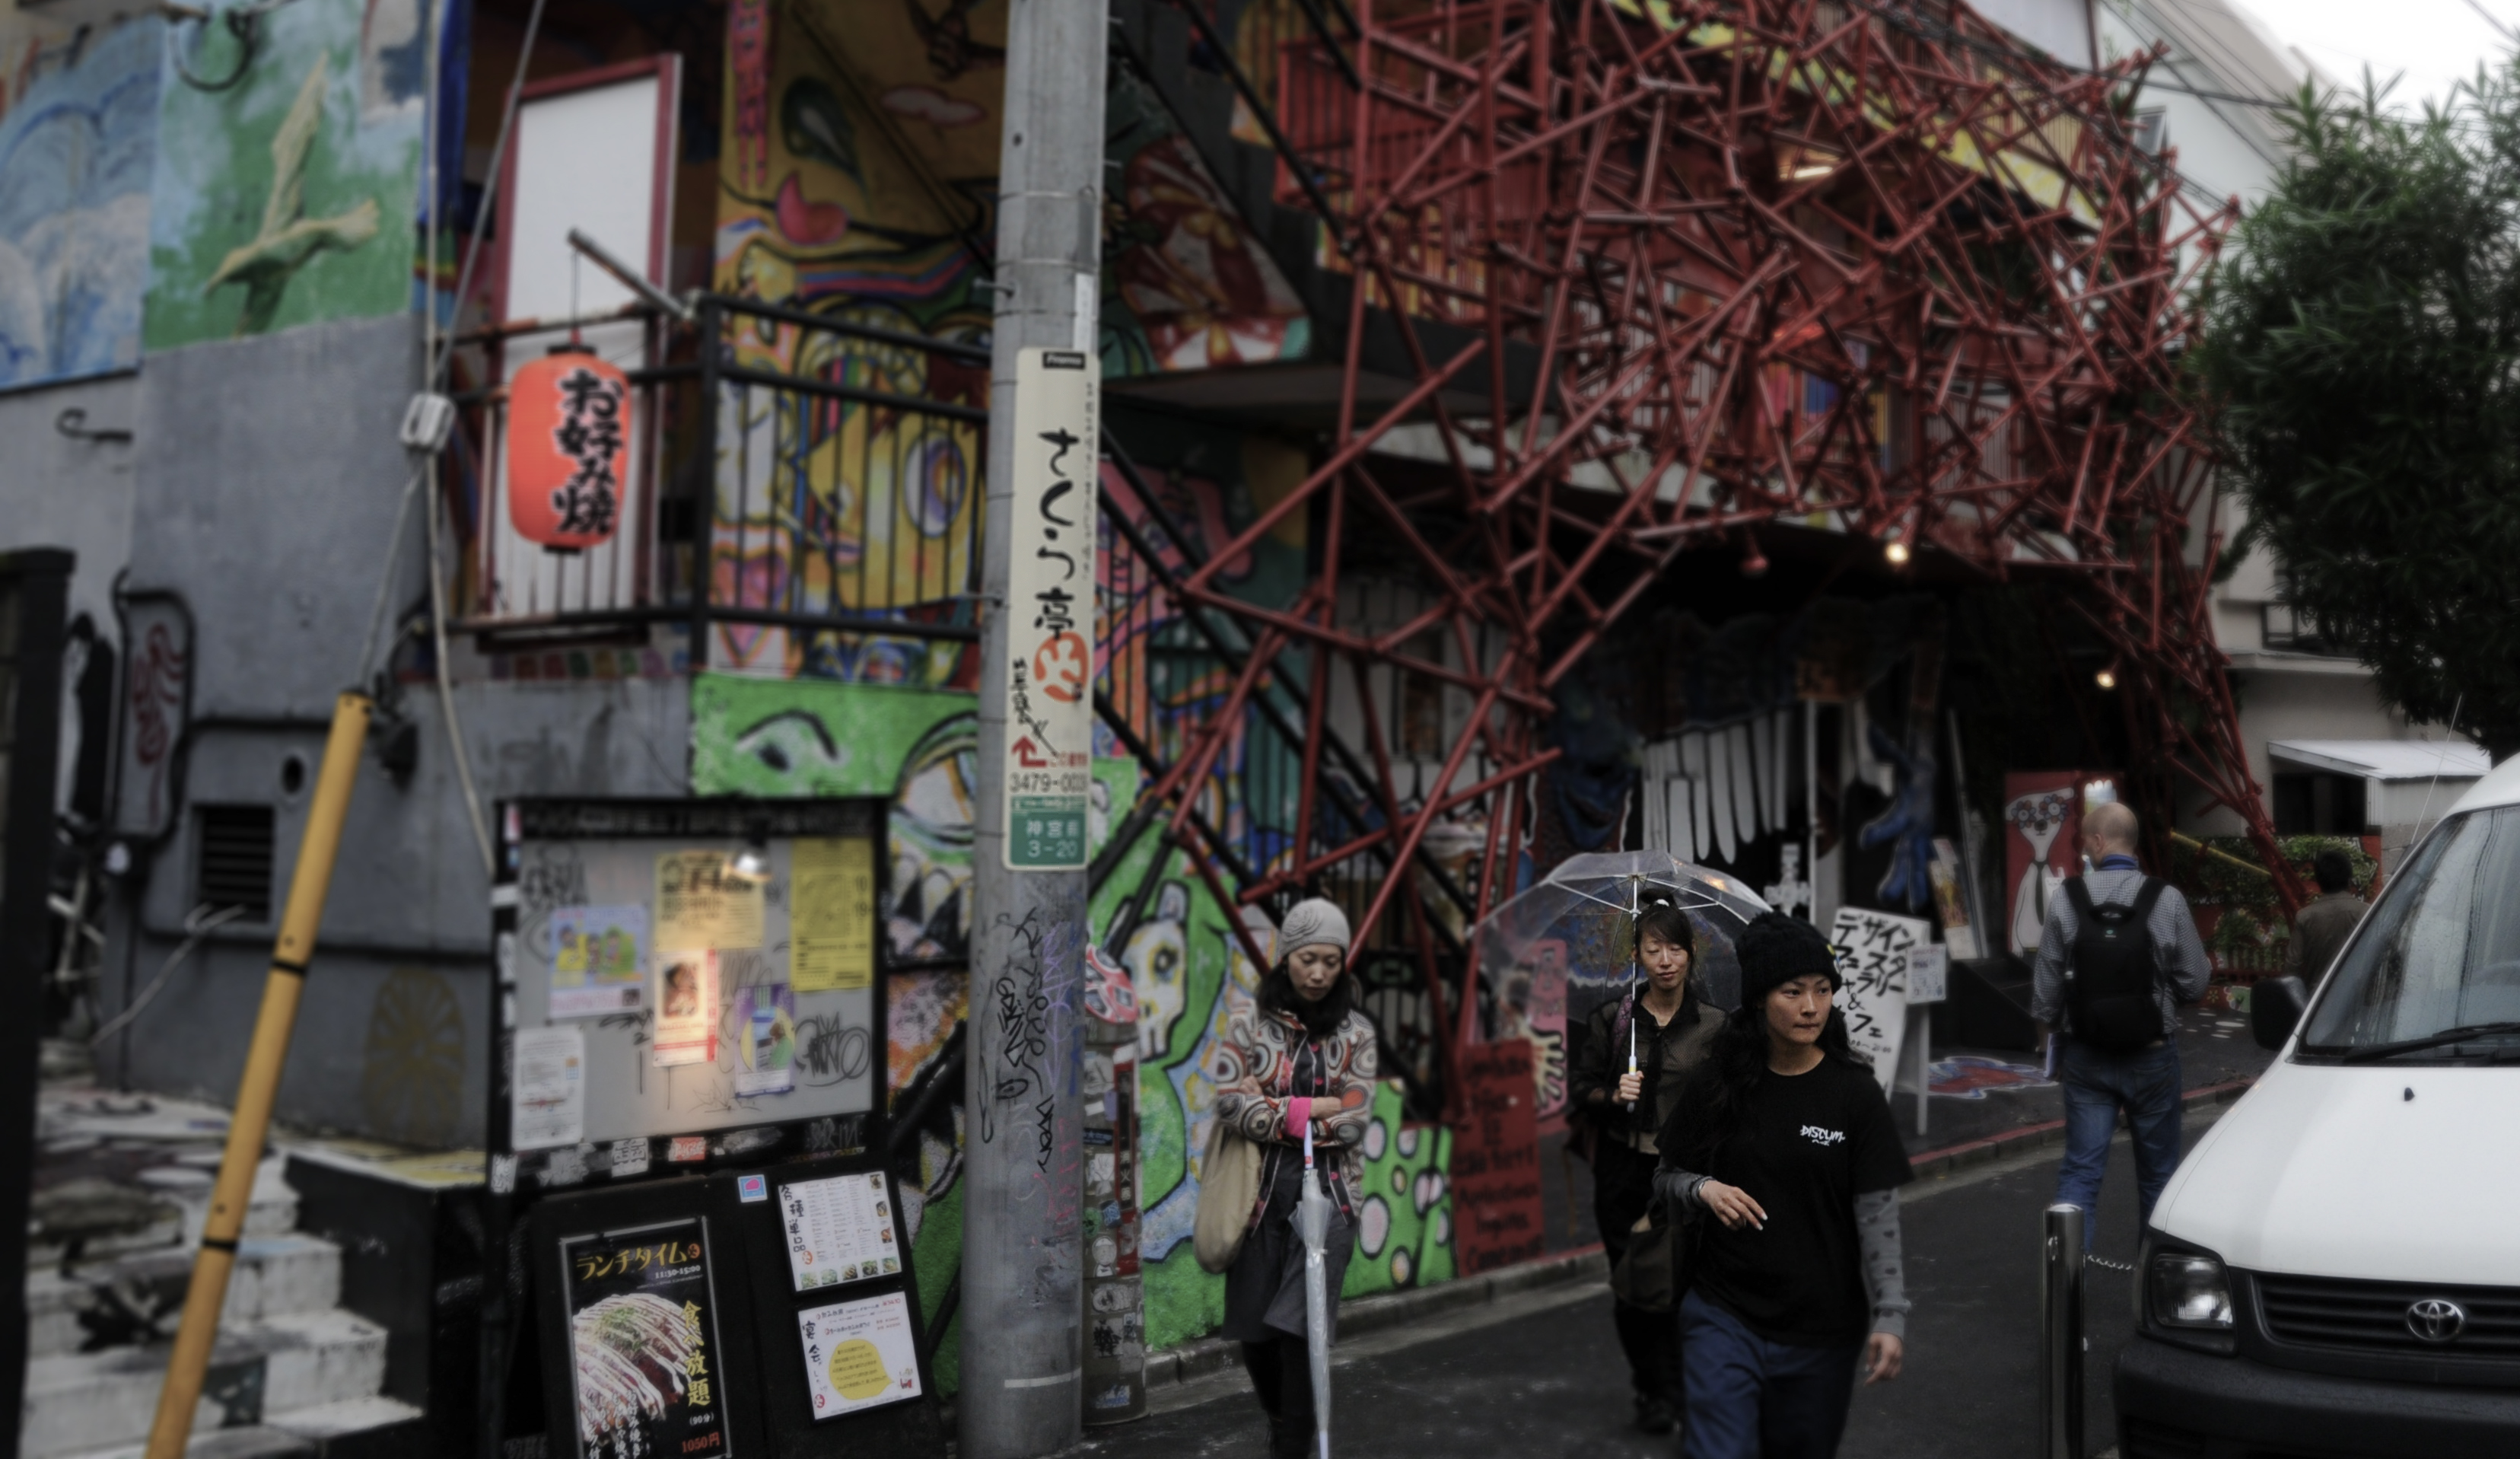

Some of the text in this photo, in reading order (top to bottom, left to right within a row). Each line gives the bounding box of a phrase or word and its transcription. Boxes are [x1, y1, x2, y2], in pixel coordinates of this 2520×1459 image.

[552, 368, 624, 537] お好み焼
[1035, 426, 1080, 639] さくら亭
[1028, 839, 1078, 859] 3-20
[1835, 913, 1917, 952] デザイン
[1841, 972, 1905, 996] ャラリー
[1848, 993, 1866, 1011] &
[781, 1185, 806, 1253] 各種単品
[576, 1241, 688, 1282] ランチタイム
[681, 1299, 711, 1407] 食べ放題
[682, 1431, 721, 1455] 1050円
